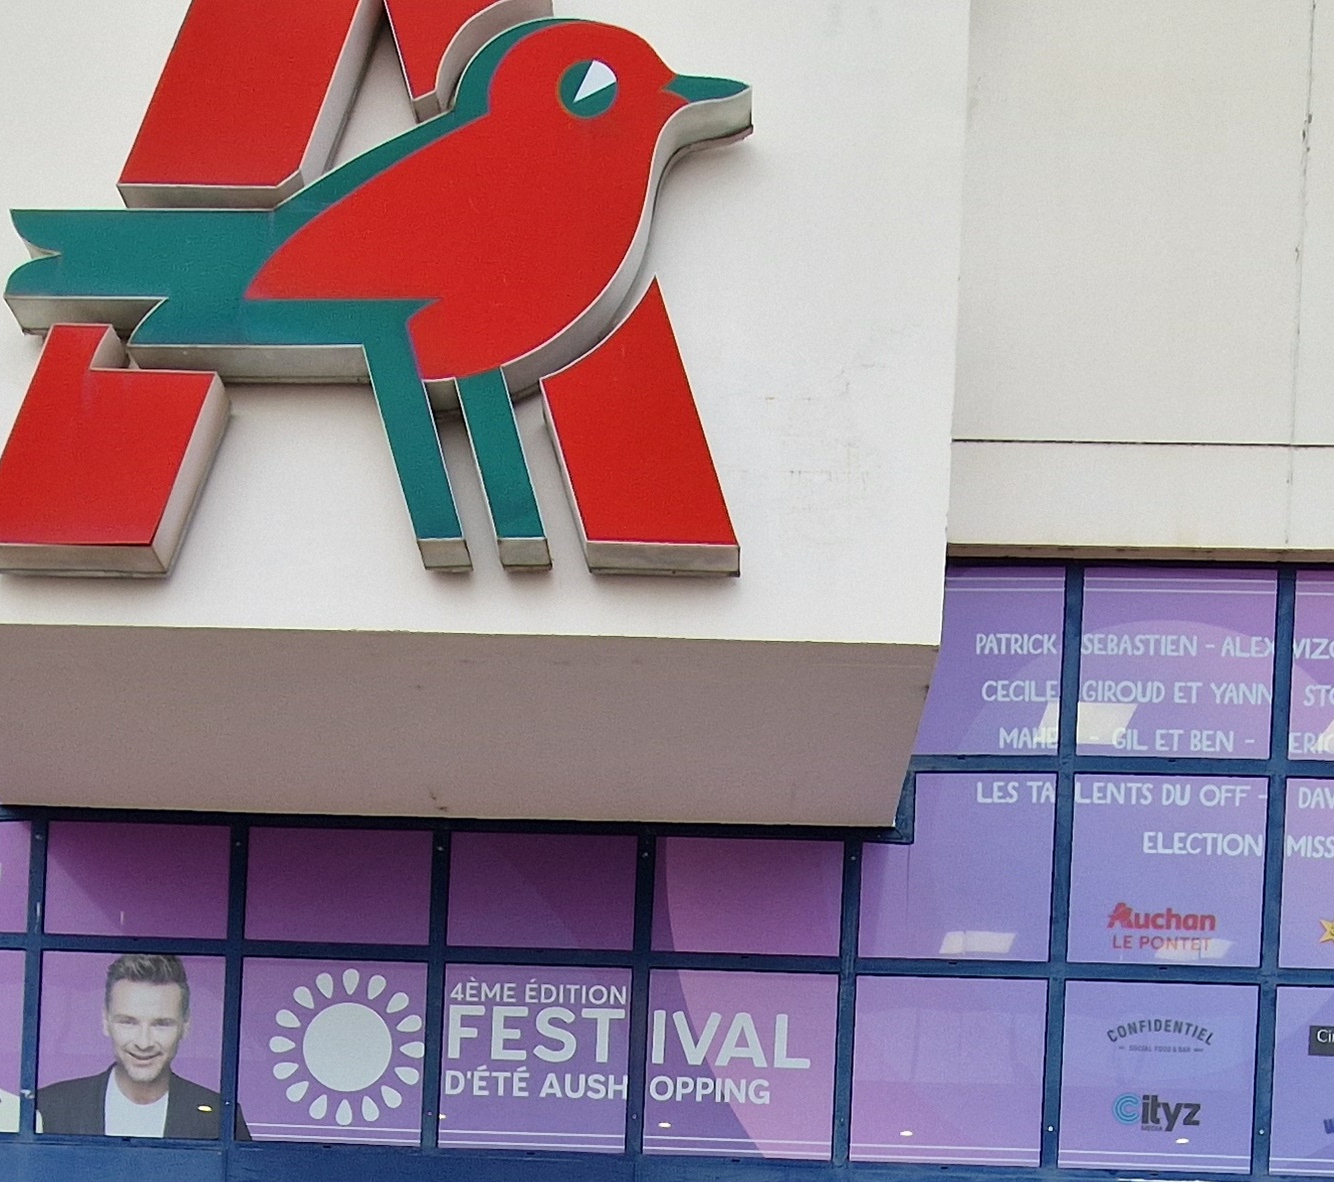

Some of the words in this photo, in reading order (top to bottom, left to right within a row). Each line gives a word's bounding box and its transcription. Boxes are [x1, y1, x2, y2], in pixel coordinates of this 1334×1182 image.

[975, 633, 1058, 656] PATRICK
[1080, 633, 1198, 657] SEBASTIEN
[981, 680, 1059, 702] CECILE
[1081, 680, 1166, 704] GIROUD
[1173, 681, 1203, 704] ET
[1209, 682, 1273, 705] YANN
[1111, 728, 1149, 751] GIL
[1155, 729, 1185, 751] ET
[1190, 730, 1235, 752] BEN
[976, 781, 1020, 804] LES
[1161, 783, 1191, 806] DU
[1199, 784, 1252, 807] OFF
[1142, 831, 1264, 857] ELECTION
[1107, 902, 1216, 932] Auchan
[1112, 935, 1133, 949] LE
[1139, 935, 1212, 951] PONTET
[449, 977, 516, 1003] 4ÈME
[524, 978, 627, 1005] ÉDITION
[447, 1005, 811, 1069] FESTIVAL
[1106, 1019, 1214, 1046] CONFIDENTIEL
[444, 1065, 529, 1097] D'ÉTÉ
[539, 1073, 770, 1105] AUSHOPPING
[1112, 1093, 1201, 1132] Cityz
